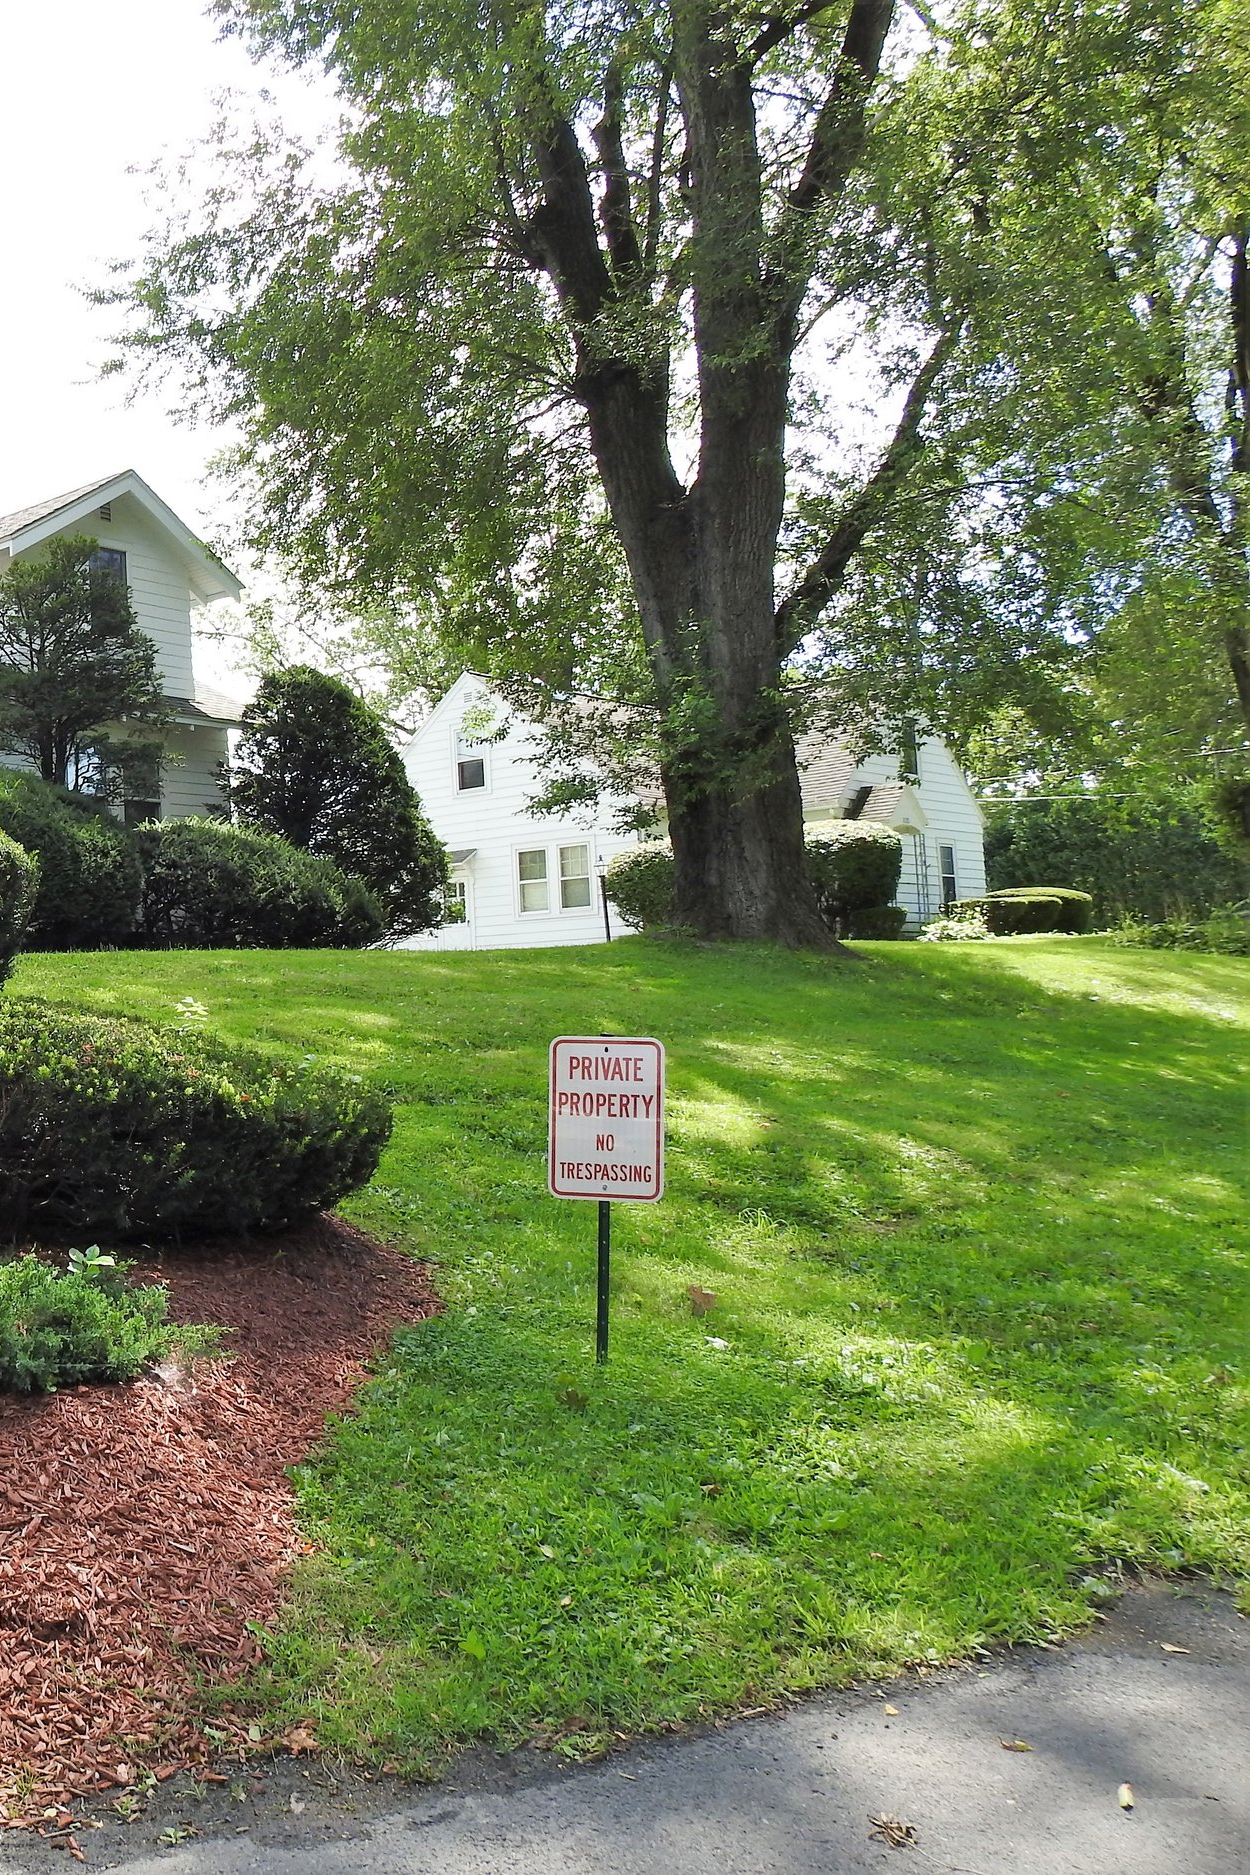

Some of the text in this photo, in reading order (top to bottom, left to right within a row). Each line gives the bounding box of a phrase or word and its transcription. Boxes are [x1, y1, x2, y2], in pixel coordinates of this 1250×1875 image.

[569, 1056, 644, 1082] PRIVATE
[558, 1092, 654, 1119] PROPERTY
[596, 1134, 615, 1151] NO
[560, 1162, 652, 1182] TRESPASSING
